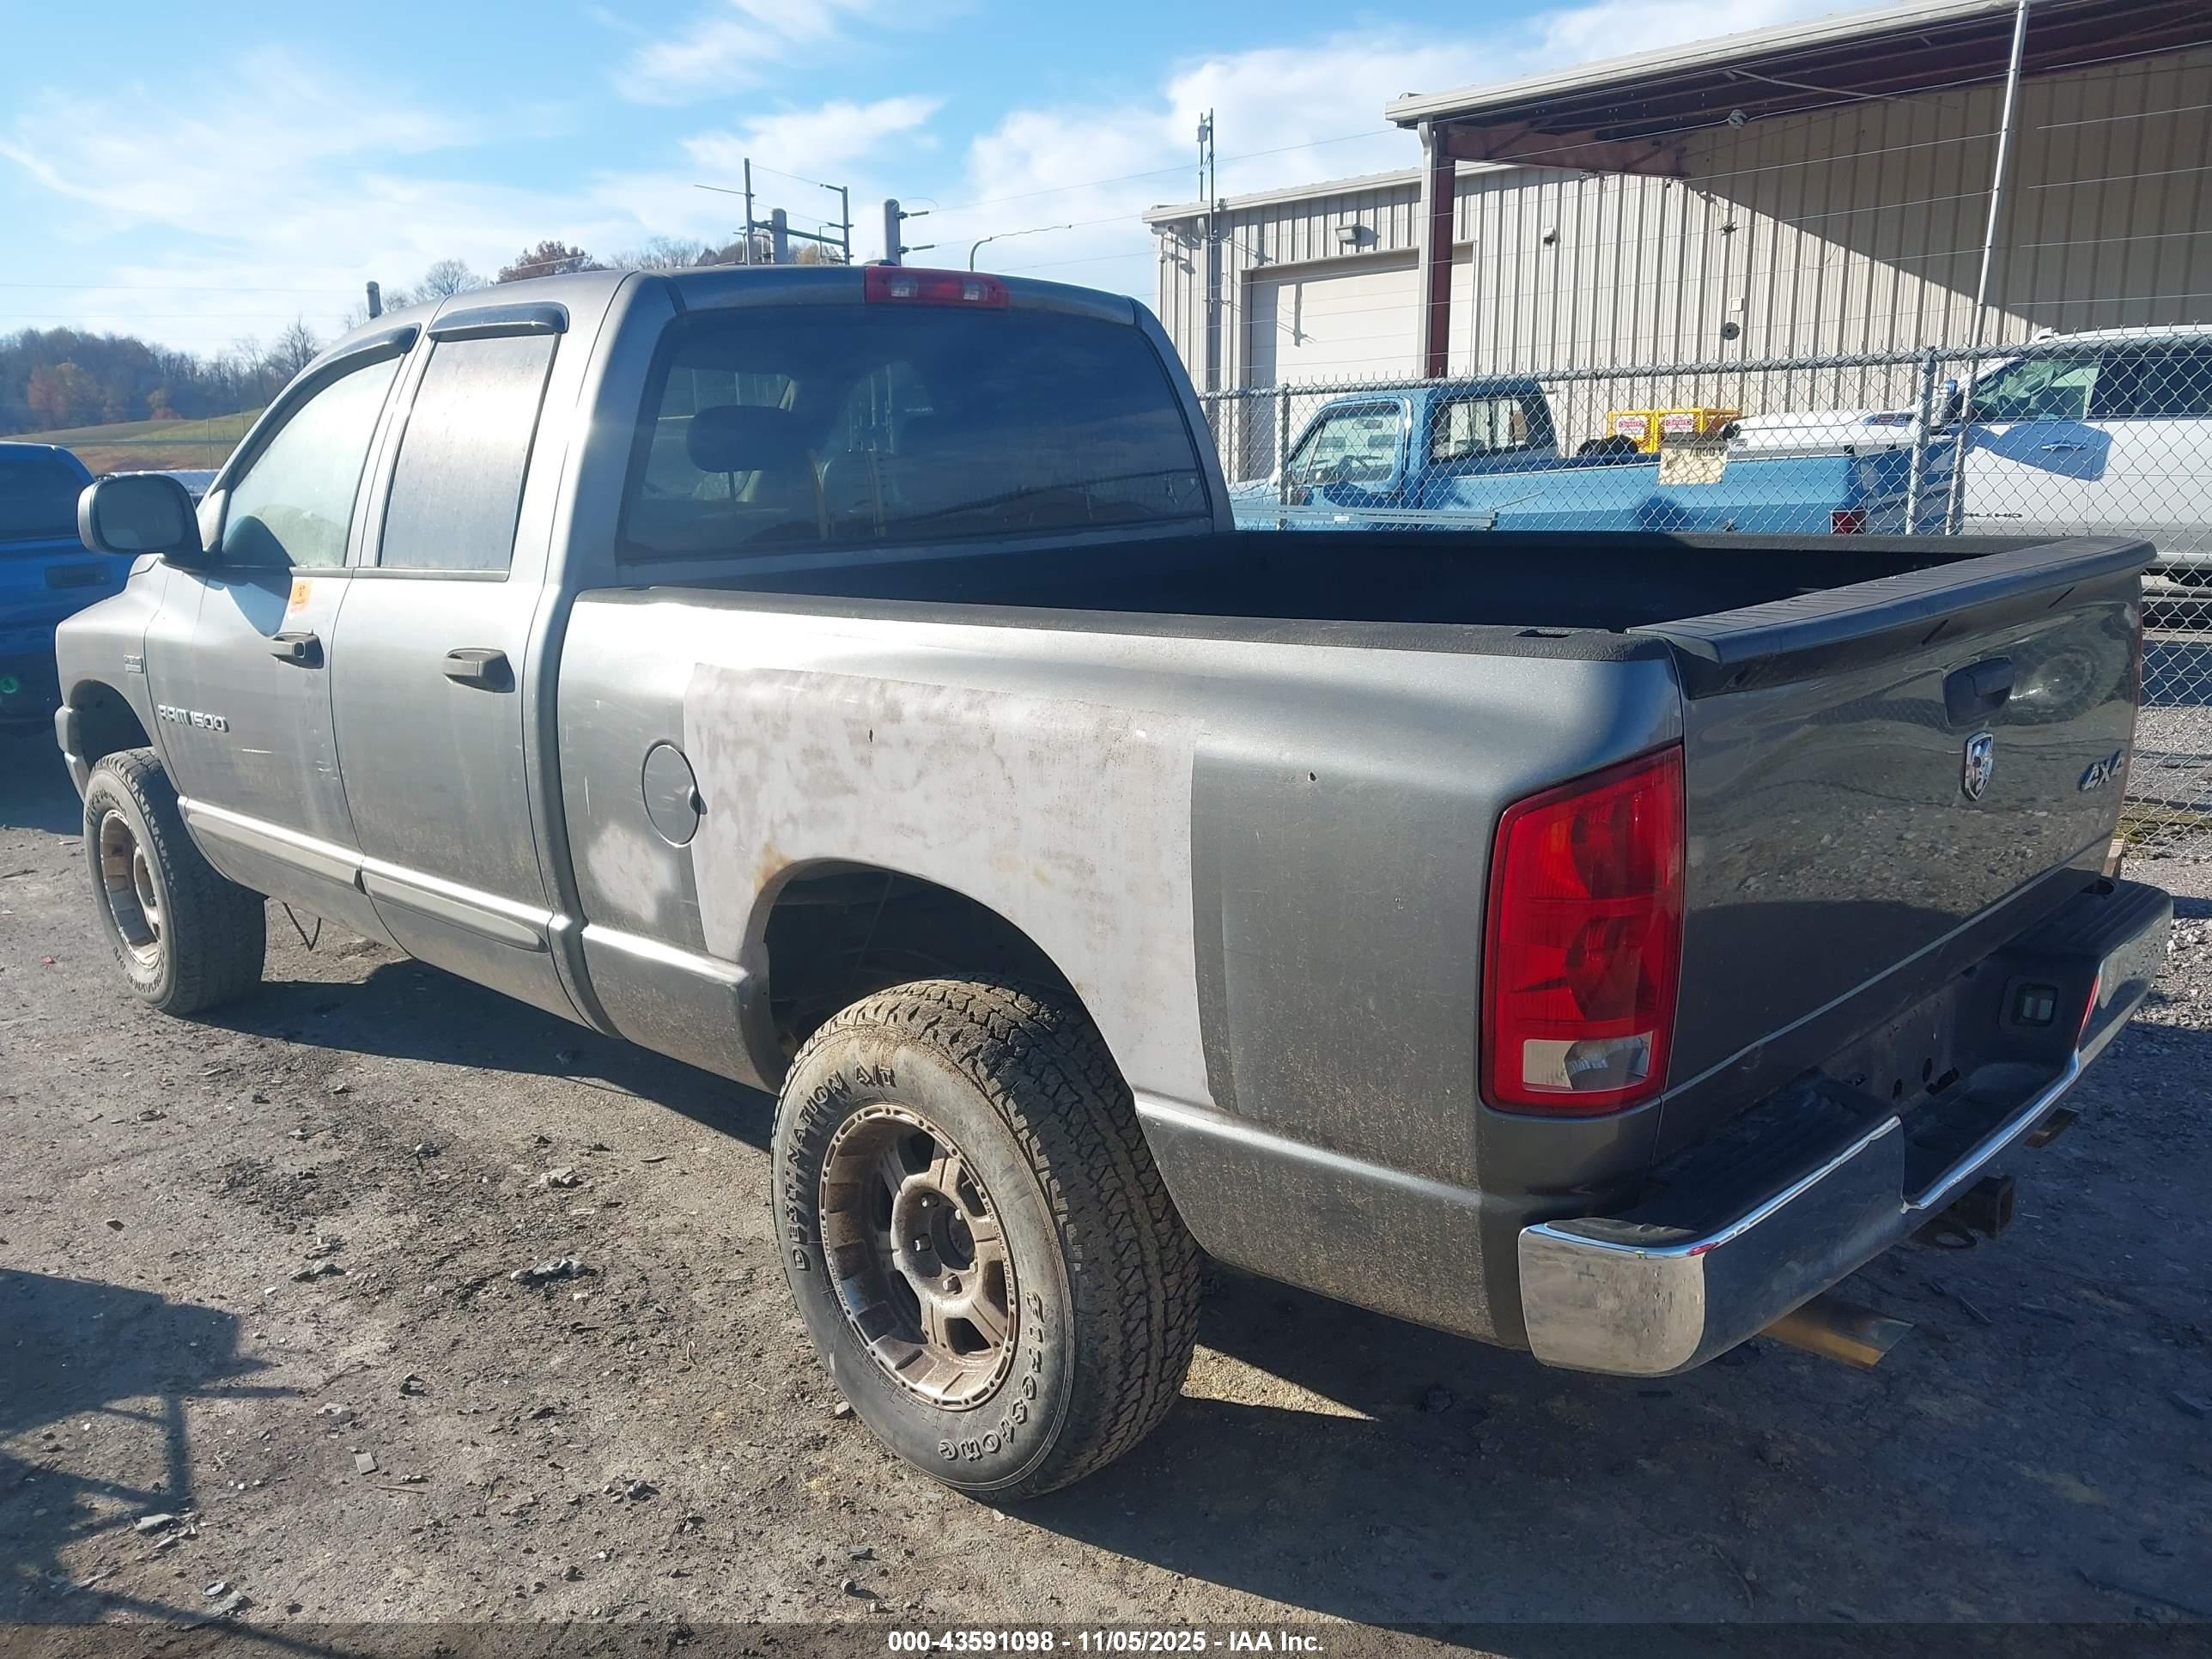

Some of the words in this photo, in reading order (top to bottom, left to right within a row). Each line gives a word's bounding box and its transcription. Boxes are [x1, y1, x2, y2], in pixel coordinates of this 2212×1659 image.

[158, 703, 191, 726] RAM
[190, 710, 229, 732] 1500
[784, 1070, 847, 1271] DESTINATION
[854, 1063, 897, 1089] A/T
[993, 1224, 1006, 1251] COMP
